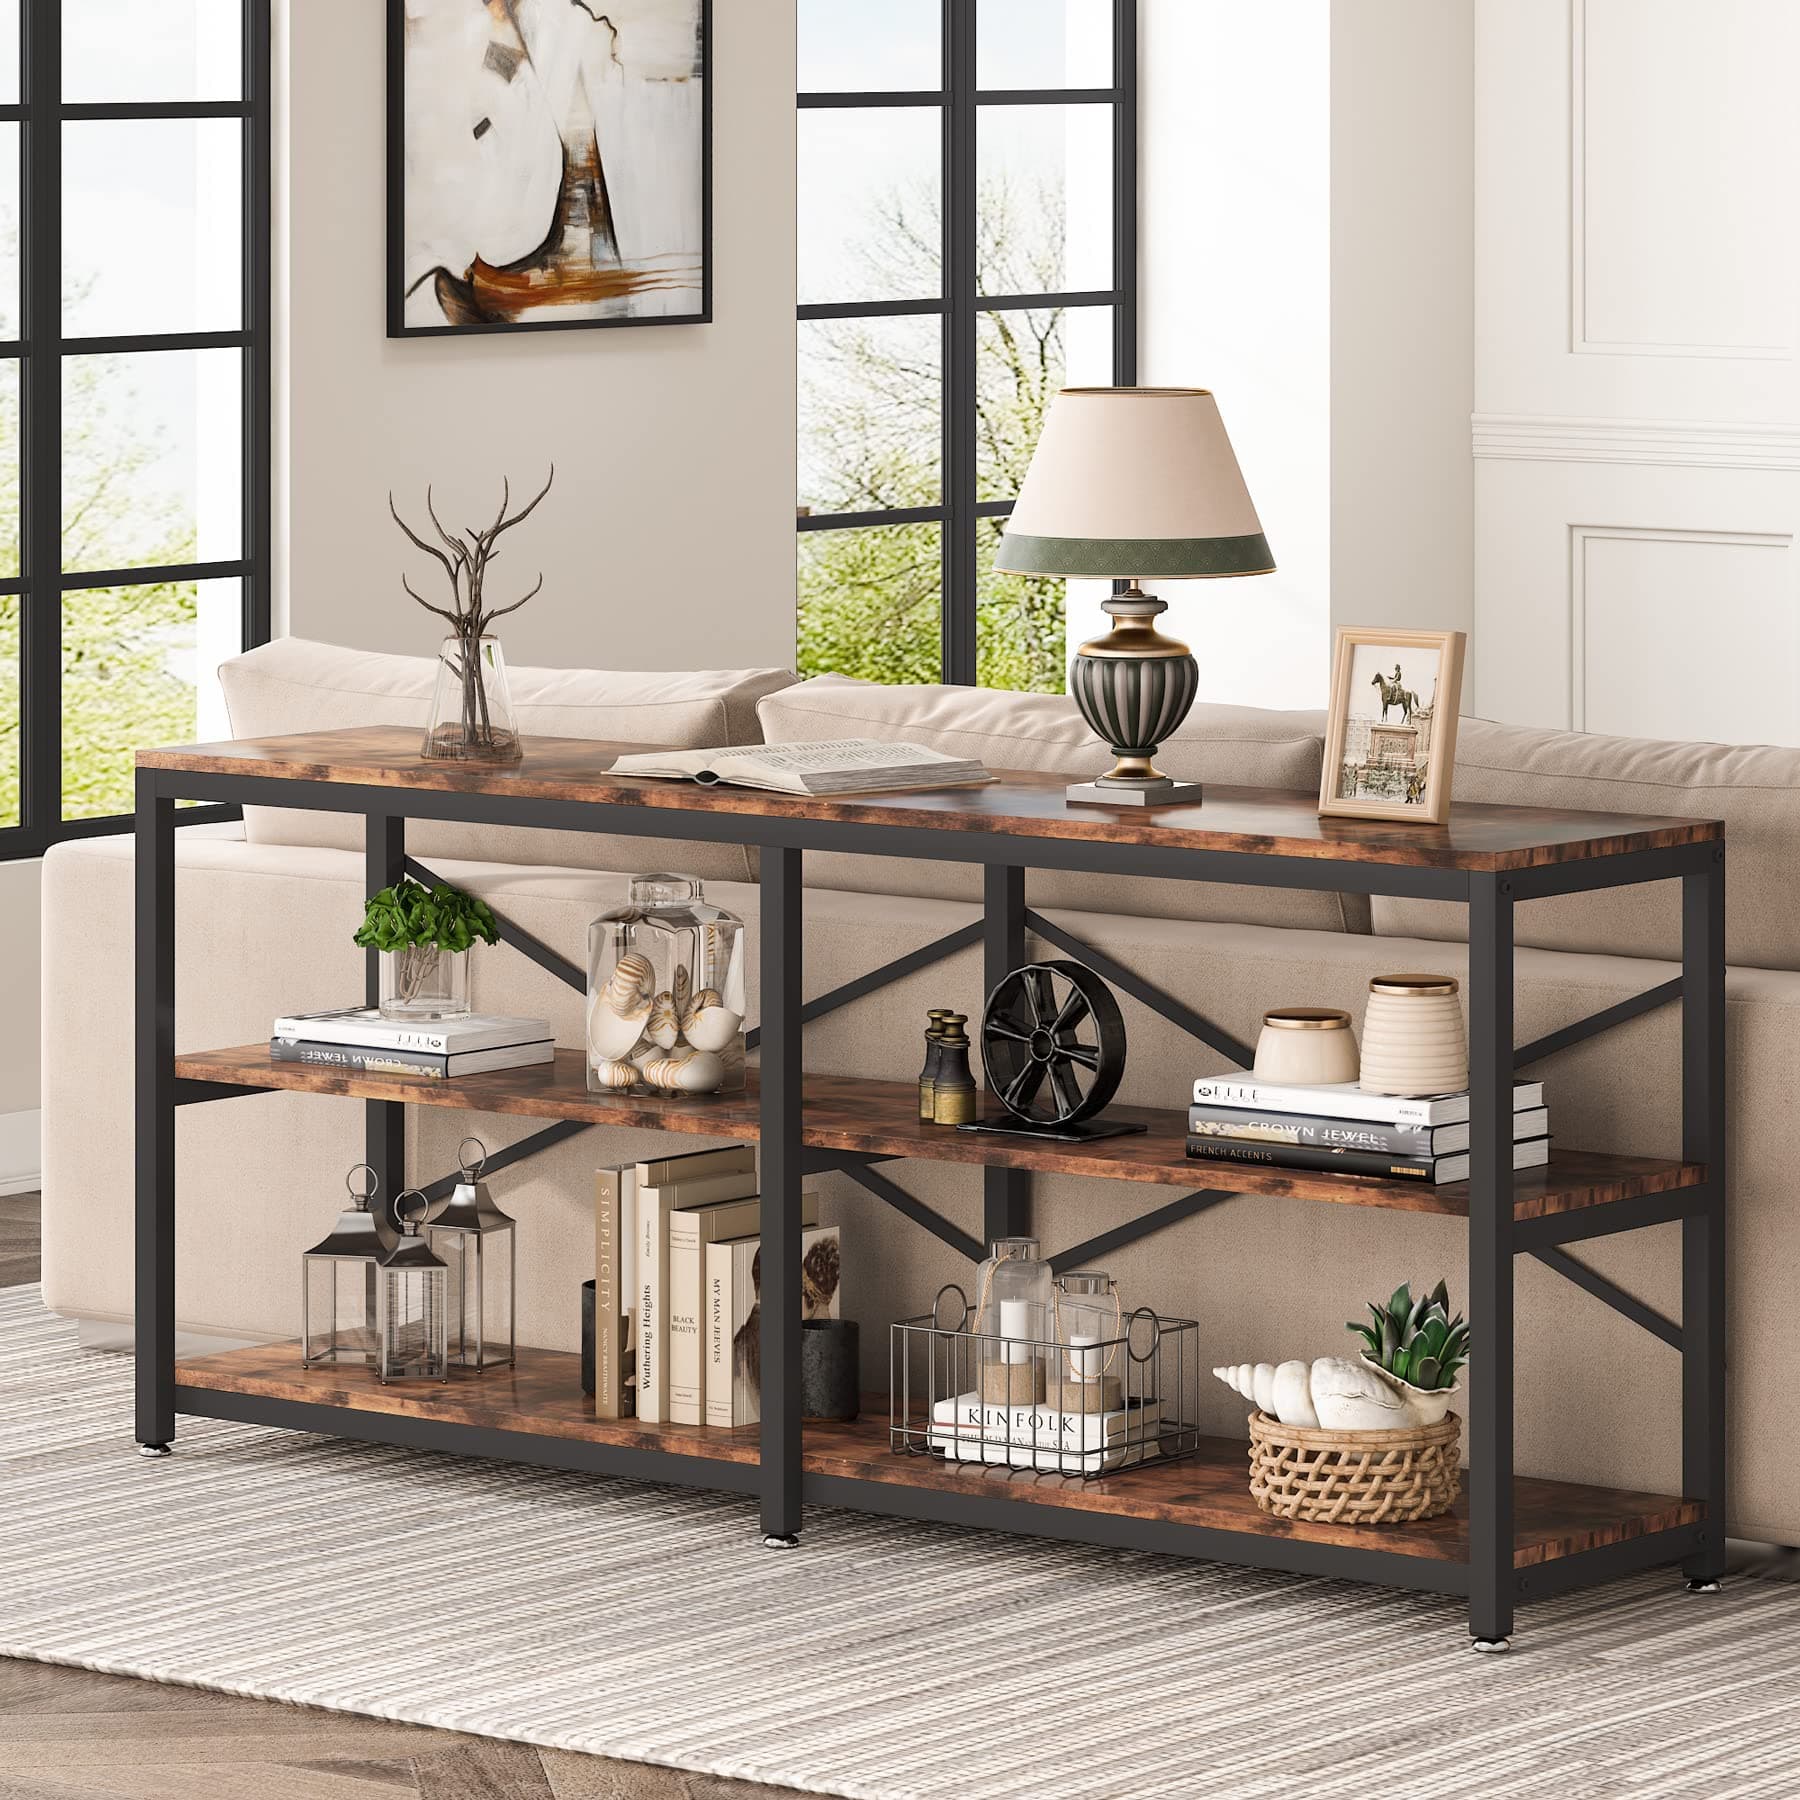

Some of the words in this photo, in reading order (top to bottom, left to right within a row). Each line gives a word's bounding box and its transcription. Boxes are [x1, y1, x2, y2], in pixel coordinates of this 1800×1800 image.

[1248, 1121, 1315, 1137] CROWN
[1321, 1128, 1379, 1144] JEWEL
[1190, 1144, 1226, 1156] FRENCH
[1230, 1149, 1272, 1161] ACCENTS
[600, 1187, 610, 1312] SIMPLICITY
[713, 1278, 721, 1296] MY
[642, 1284, 653, 1327] Heights
[713, 1298, 721, 1323] MAN
[671, 1324, 698, 1334] BEAUTY
[672, 1314, 695, 1325] BLACK
[713, 1326, 721, 1364] JEEVES
[642, 1331, 653, 1390] Wuthering
[968, 1408, 1076, 1433] KINFOLK
